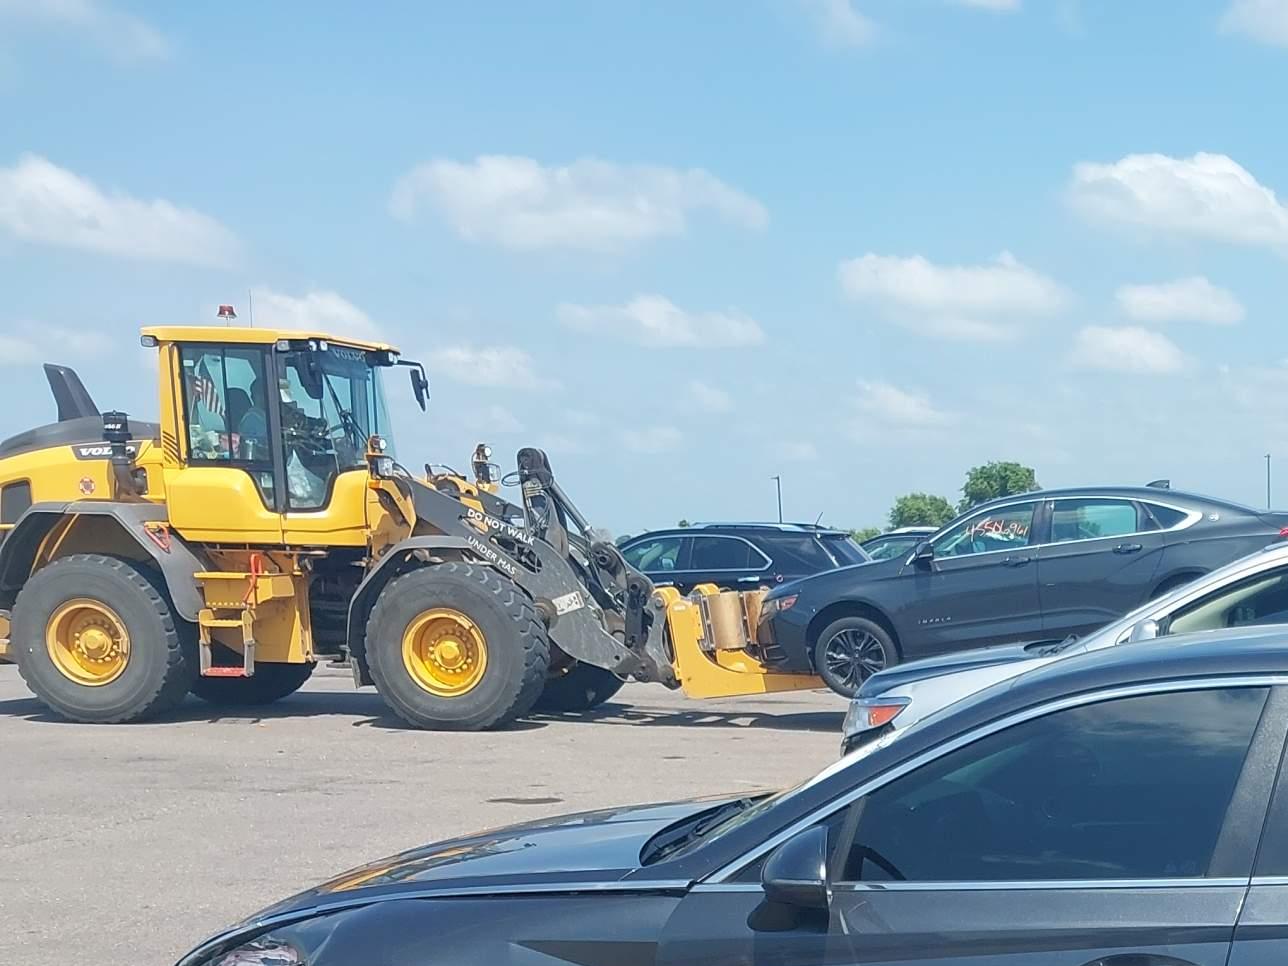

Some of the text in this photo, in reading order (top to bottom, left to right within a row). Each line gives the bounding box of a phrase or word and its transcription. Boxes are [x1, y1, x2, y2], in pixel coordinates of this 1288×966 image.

[80, 446, 135, 456] VOLO
[467, 508, 535, 546] DO NOT WALK
[467, 536, 498, 562] UNDER
